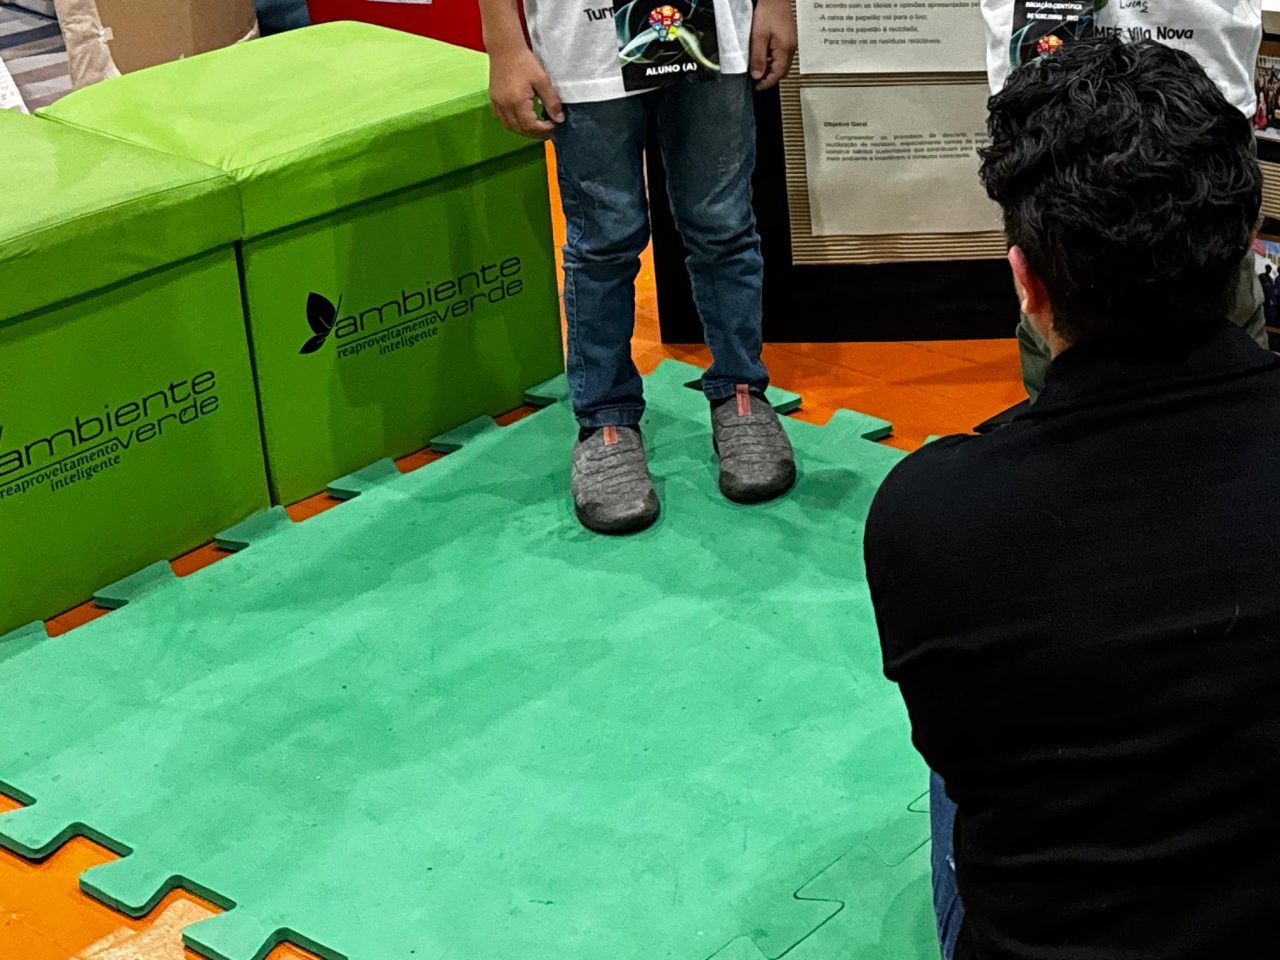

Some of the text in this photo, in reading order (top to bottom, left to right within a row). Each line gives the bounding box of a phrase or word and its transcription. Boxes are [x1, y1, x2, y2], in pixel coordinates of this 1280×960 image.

[1157, 26, 1194, 40] Nova
[646, 62, 697, 76] ALUNO (A)
[334, 255, 522, 340] ambiente
[436, 278, 524, 323] verde
[336, 313, 438, 359] reaproveitamento
[378, 325, 439, 356] inteligente
[0, 369, 217, 477] ambiente
[118, 394, 220, 451] verde
[0, 441, 119, 499] reaproveitamento
[50, 453, 121, 493] inteligente
